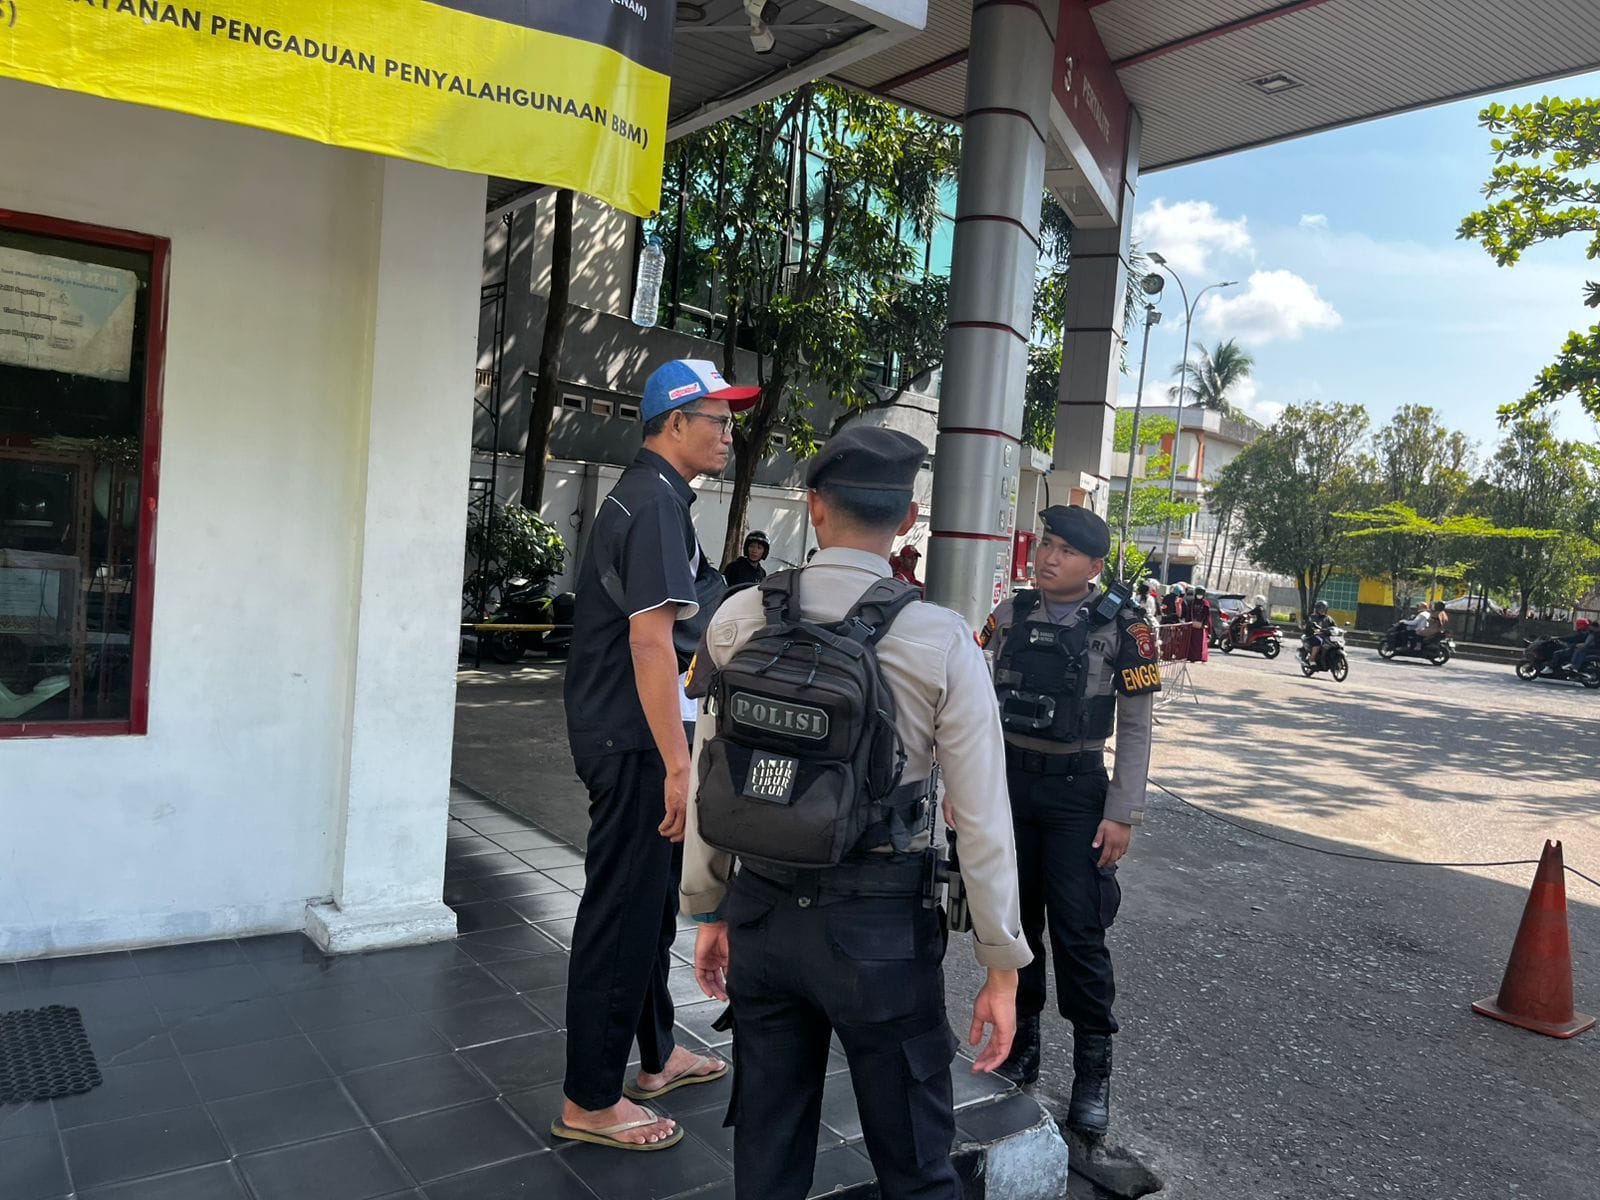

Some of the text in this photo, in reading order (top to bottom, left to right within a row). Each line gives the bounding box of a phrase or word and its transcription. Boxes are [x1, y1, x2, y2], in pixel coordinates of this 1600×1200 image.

[210, 14, 376, 74] PENGADUAN
[384, 60, 607, 127] PENYALAHGUNAAN
[610, 112, 649, 150] BBM)
[736, 698, 822, 733] POLISI
[757, 759, 792, 768] ANTI
[754, 767, 792, 779] LIBUR
[752, 776, 789, 789] LIBUR
[753, 785, 784, 797] CLUB
